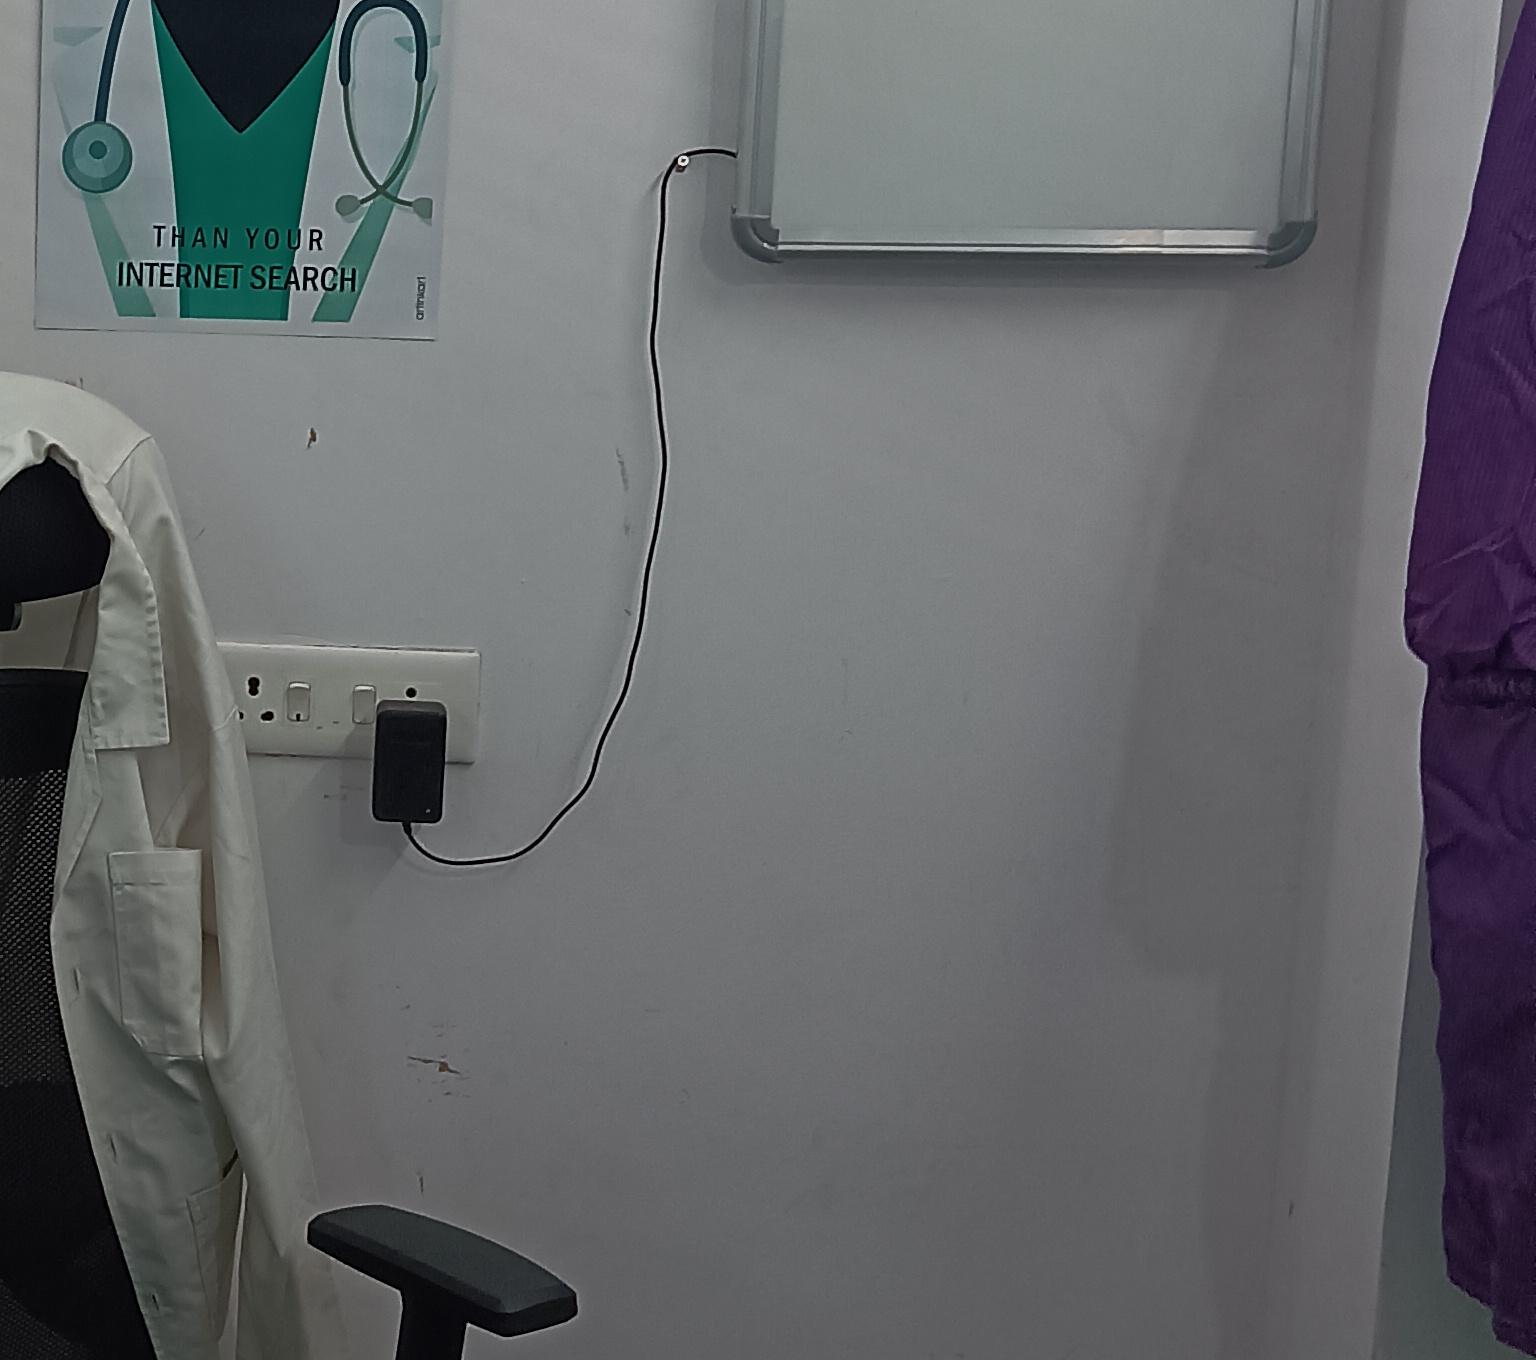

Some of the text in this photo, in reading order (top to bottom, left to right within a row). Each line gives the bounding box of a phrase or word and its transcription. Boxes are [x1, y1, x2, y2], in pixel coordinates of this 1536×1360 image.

[153, 225, 324, 251] THAN YOUR
[117, 262, 357, 292] INTERNET SEARCH
